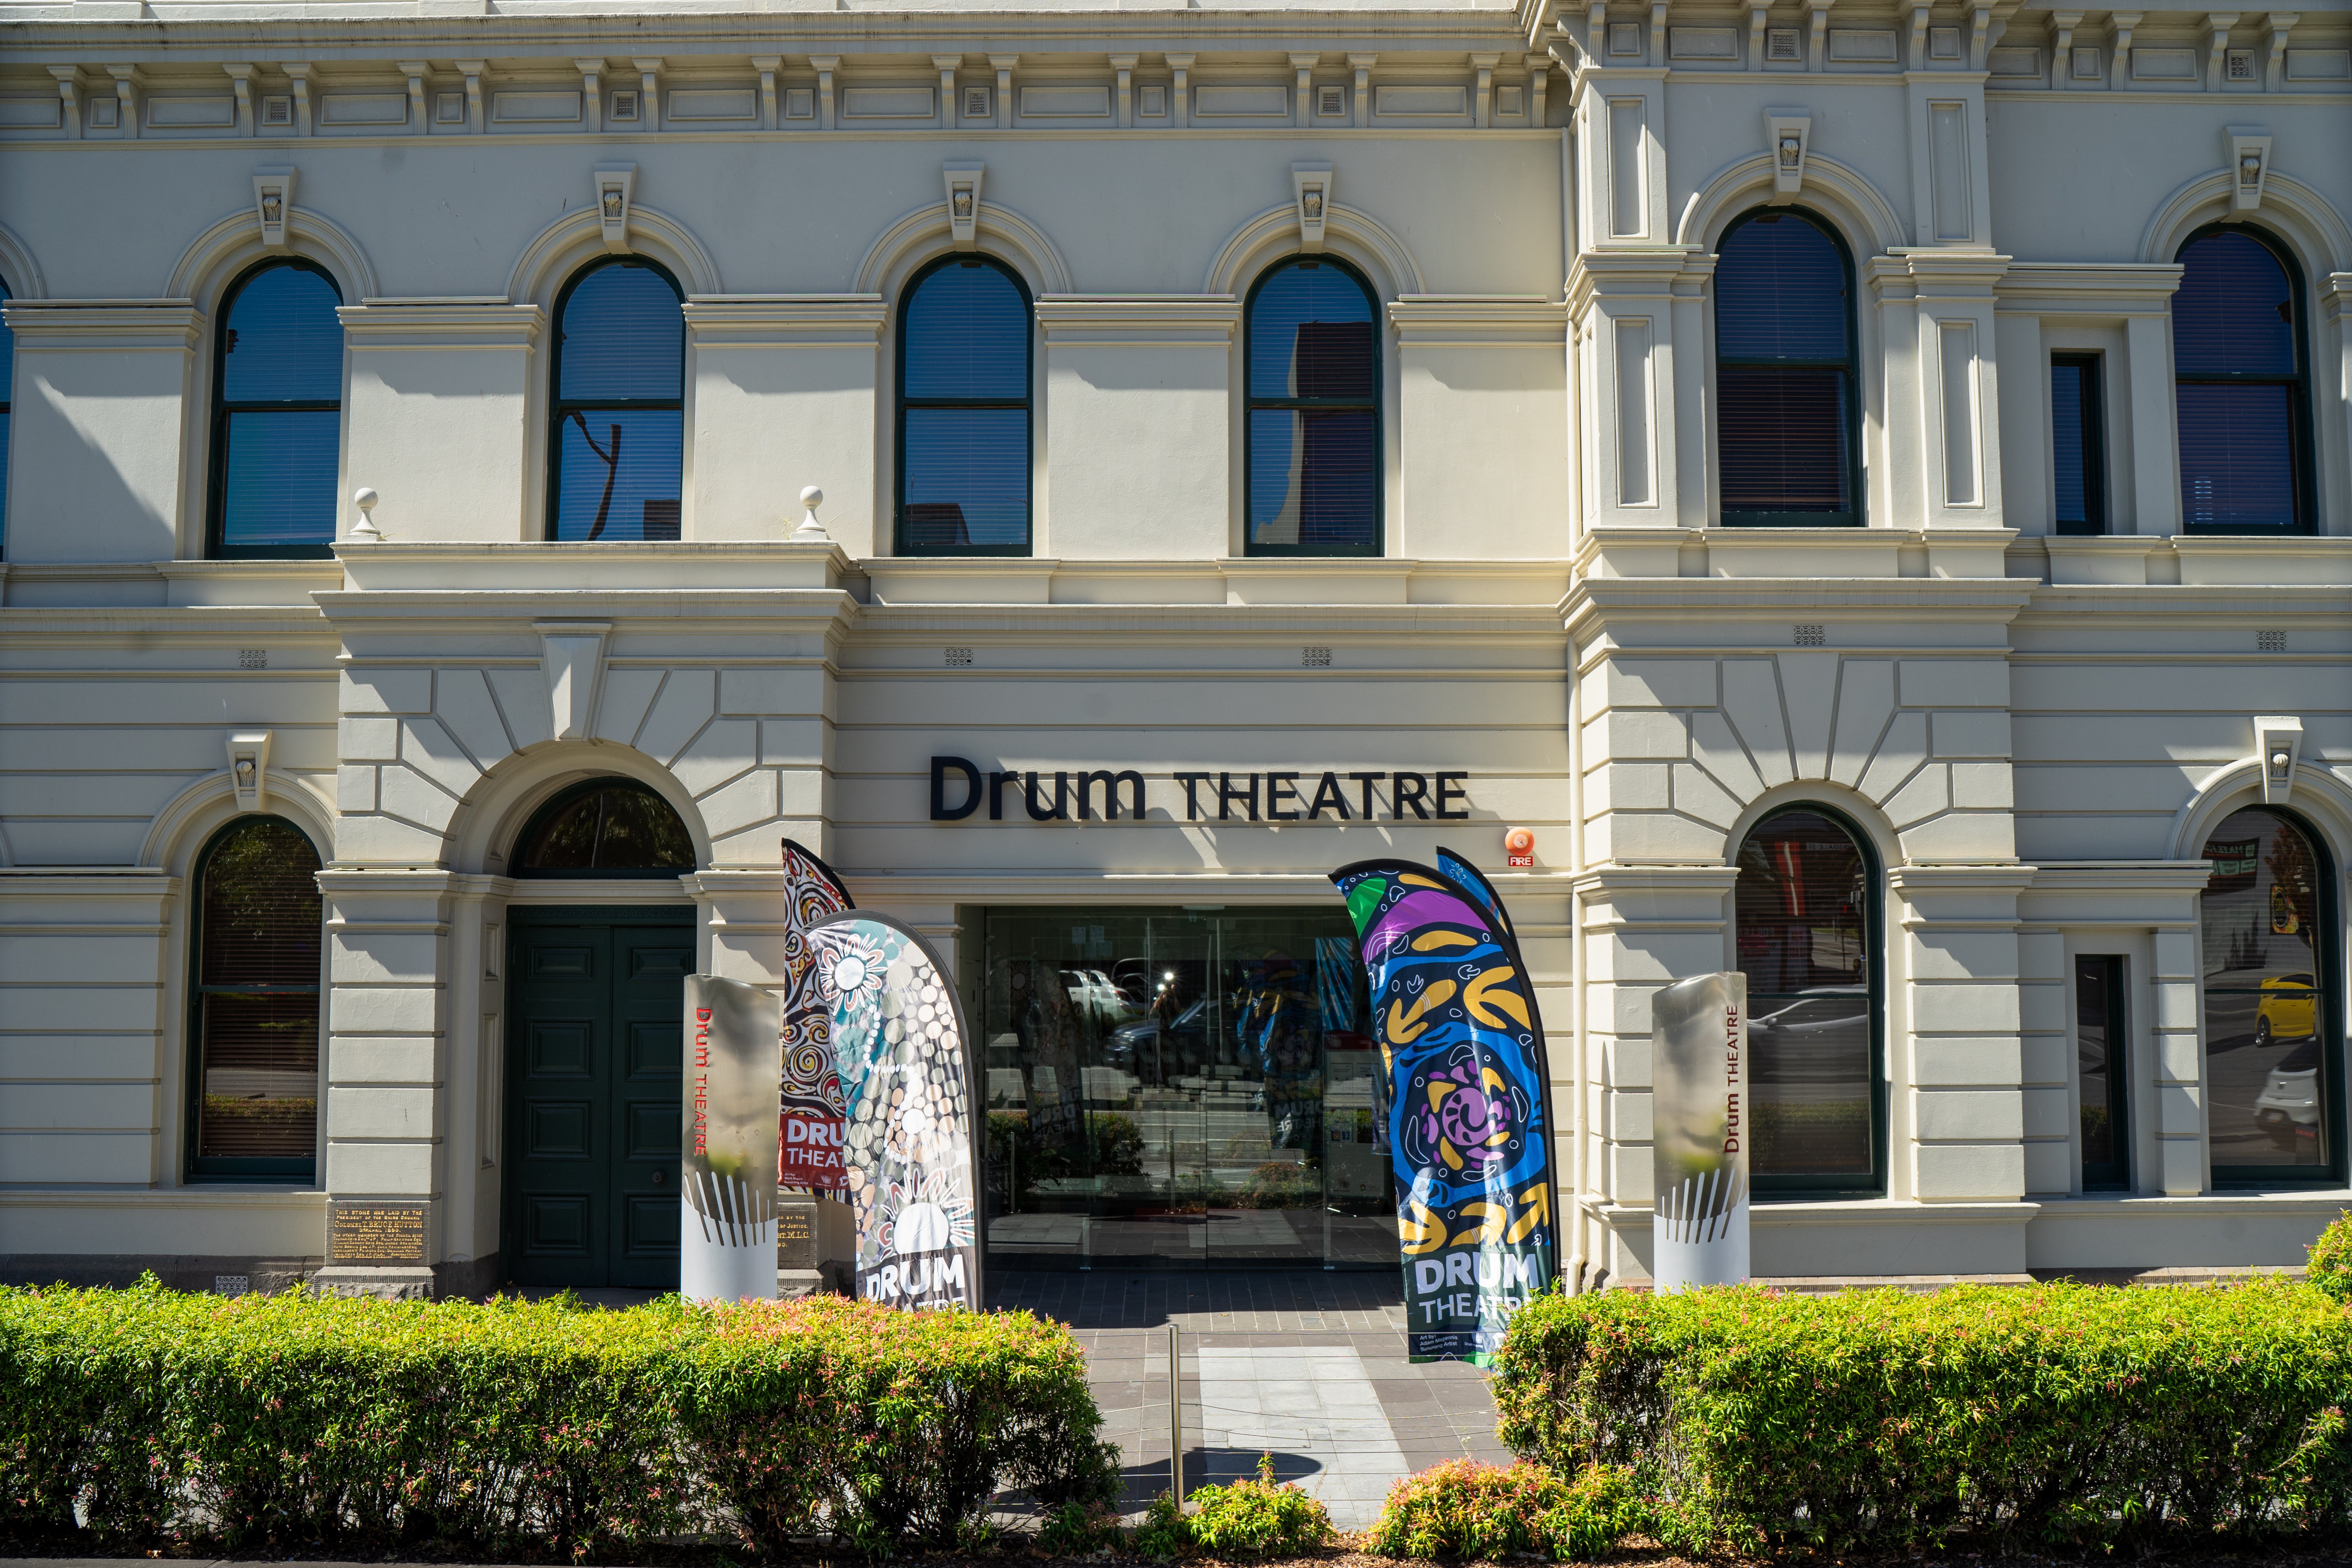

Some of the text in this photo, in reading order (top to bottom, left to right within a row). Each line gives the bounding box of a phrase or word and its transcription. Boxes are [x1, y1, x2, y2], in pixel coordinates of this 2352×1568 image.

[930, 756, 1468, 821] Drum THEATRE
[1510, 857, 1532, 865] FIRE
[695, 1008, 712, 1156] Drum THEATRE
[1725, 1006, 1739, 1153] Drum THEATRE
[787, 1119, 846, 1147] DRU
[787, 1148, 846, 1168] THEAT
[866, 1254, 965, 1302] DRUM
[1415, 1252, 1539, 1294] DRUM
